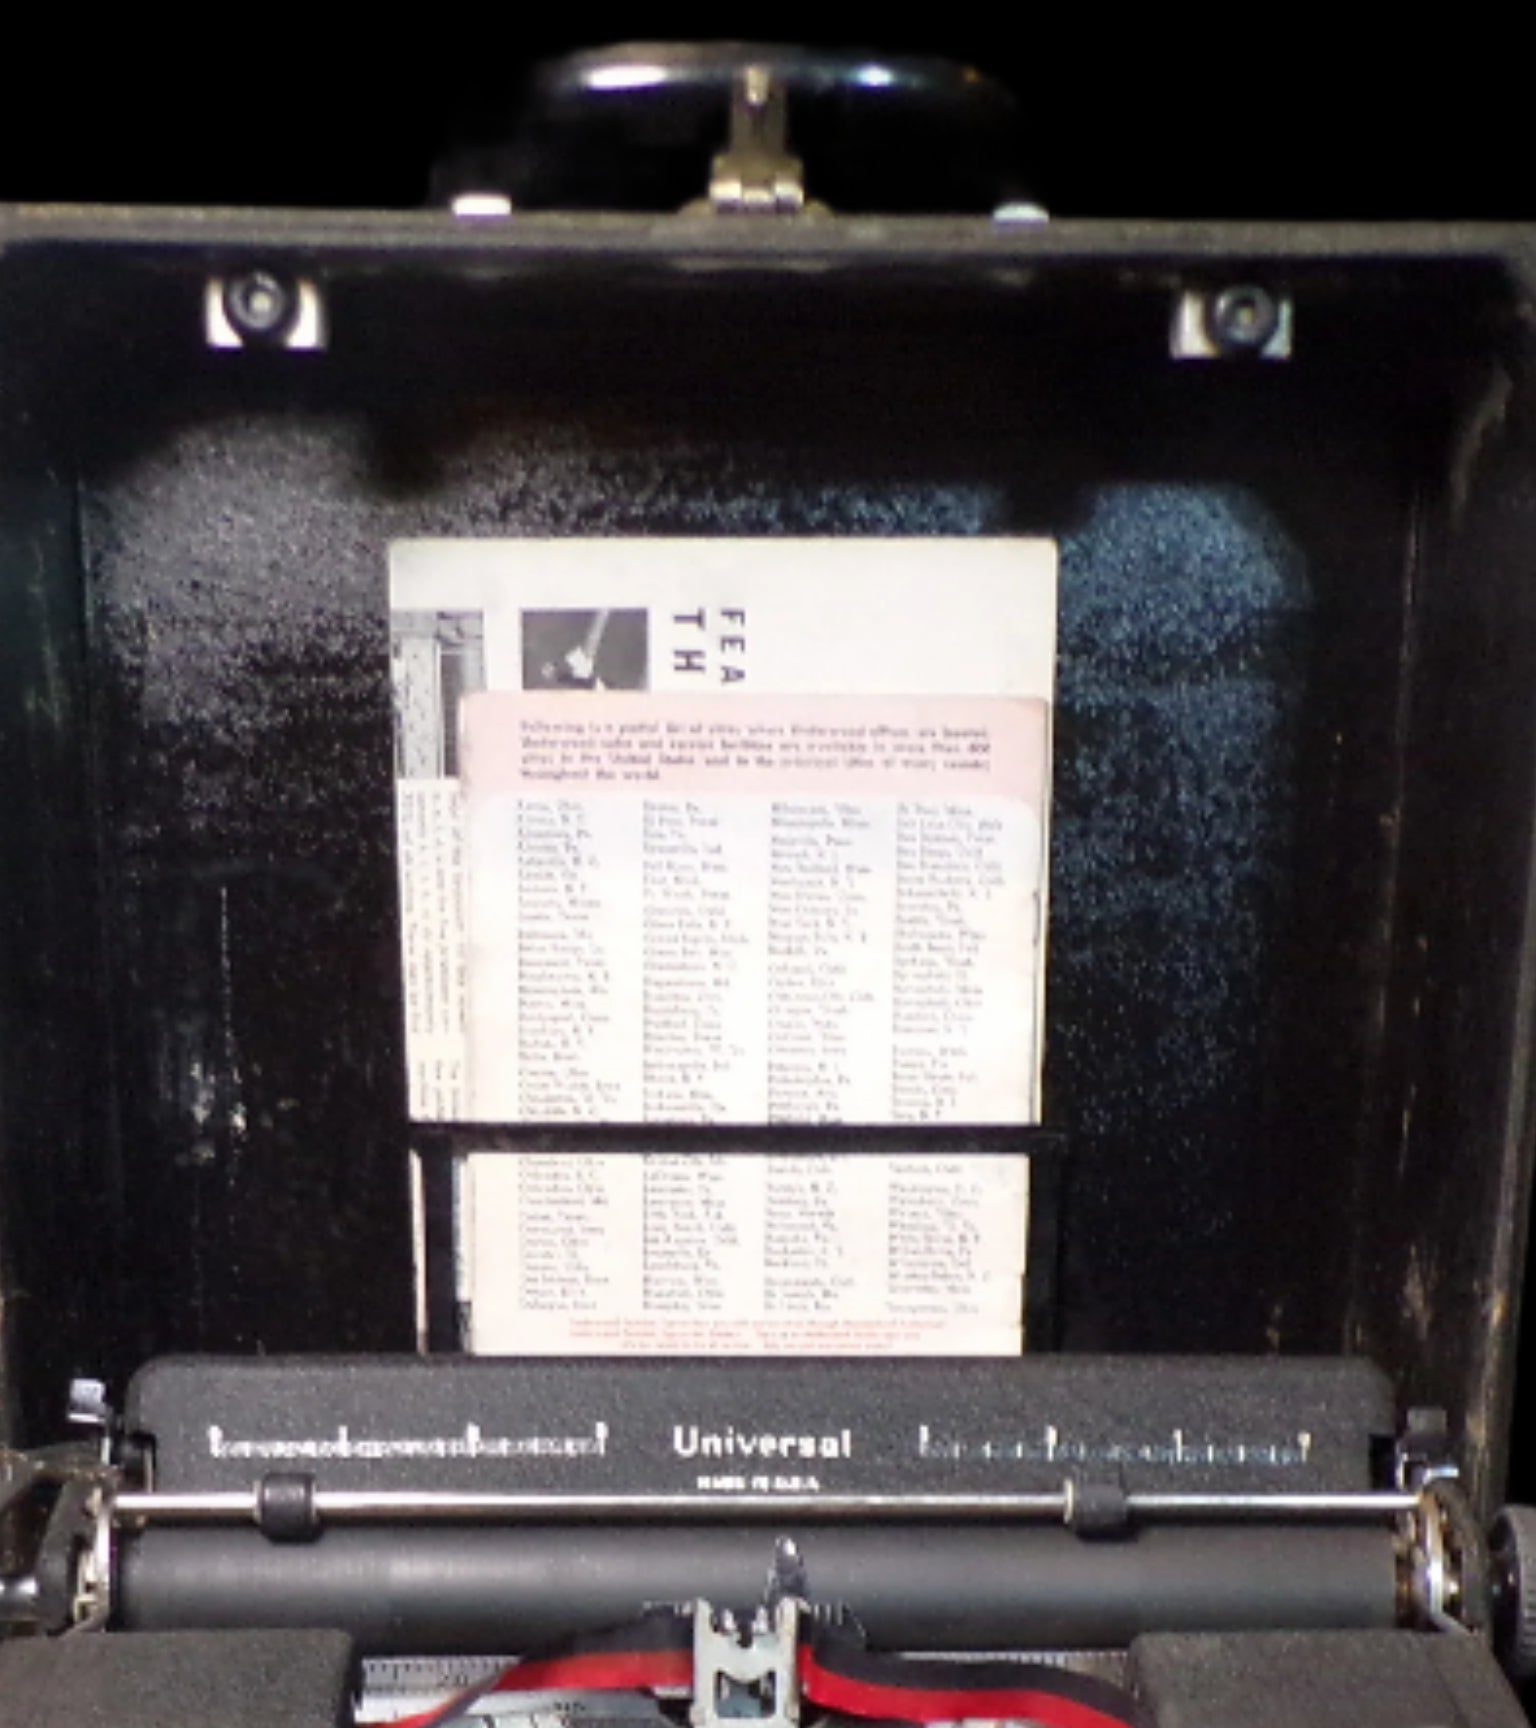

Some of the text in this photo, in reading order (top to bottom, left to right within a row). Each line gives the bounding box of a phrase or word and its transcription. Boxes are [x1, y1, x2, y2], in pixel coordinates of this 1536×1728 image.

[673, 608, 706, 674] TH
[721, 608, 746, 684] FEA
[672, 1425, 852, 1459] Universal
